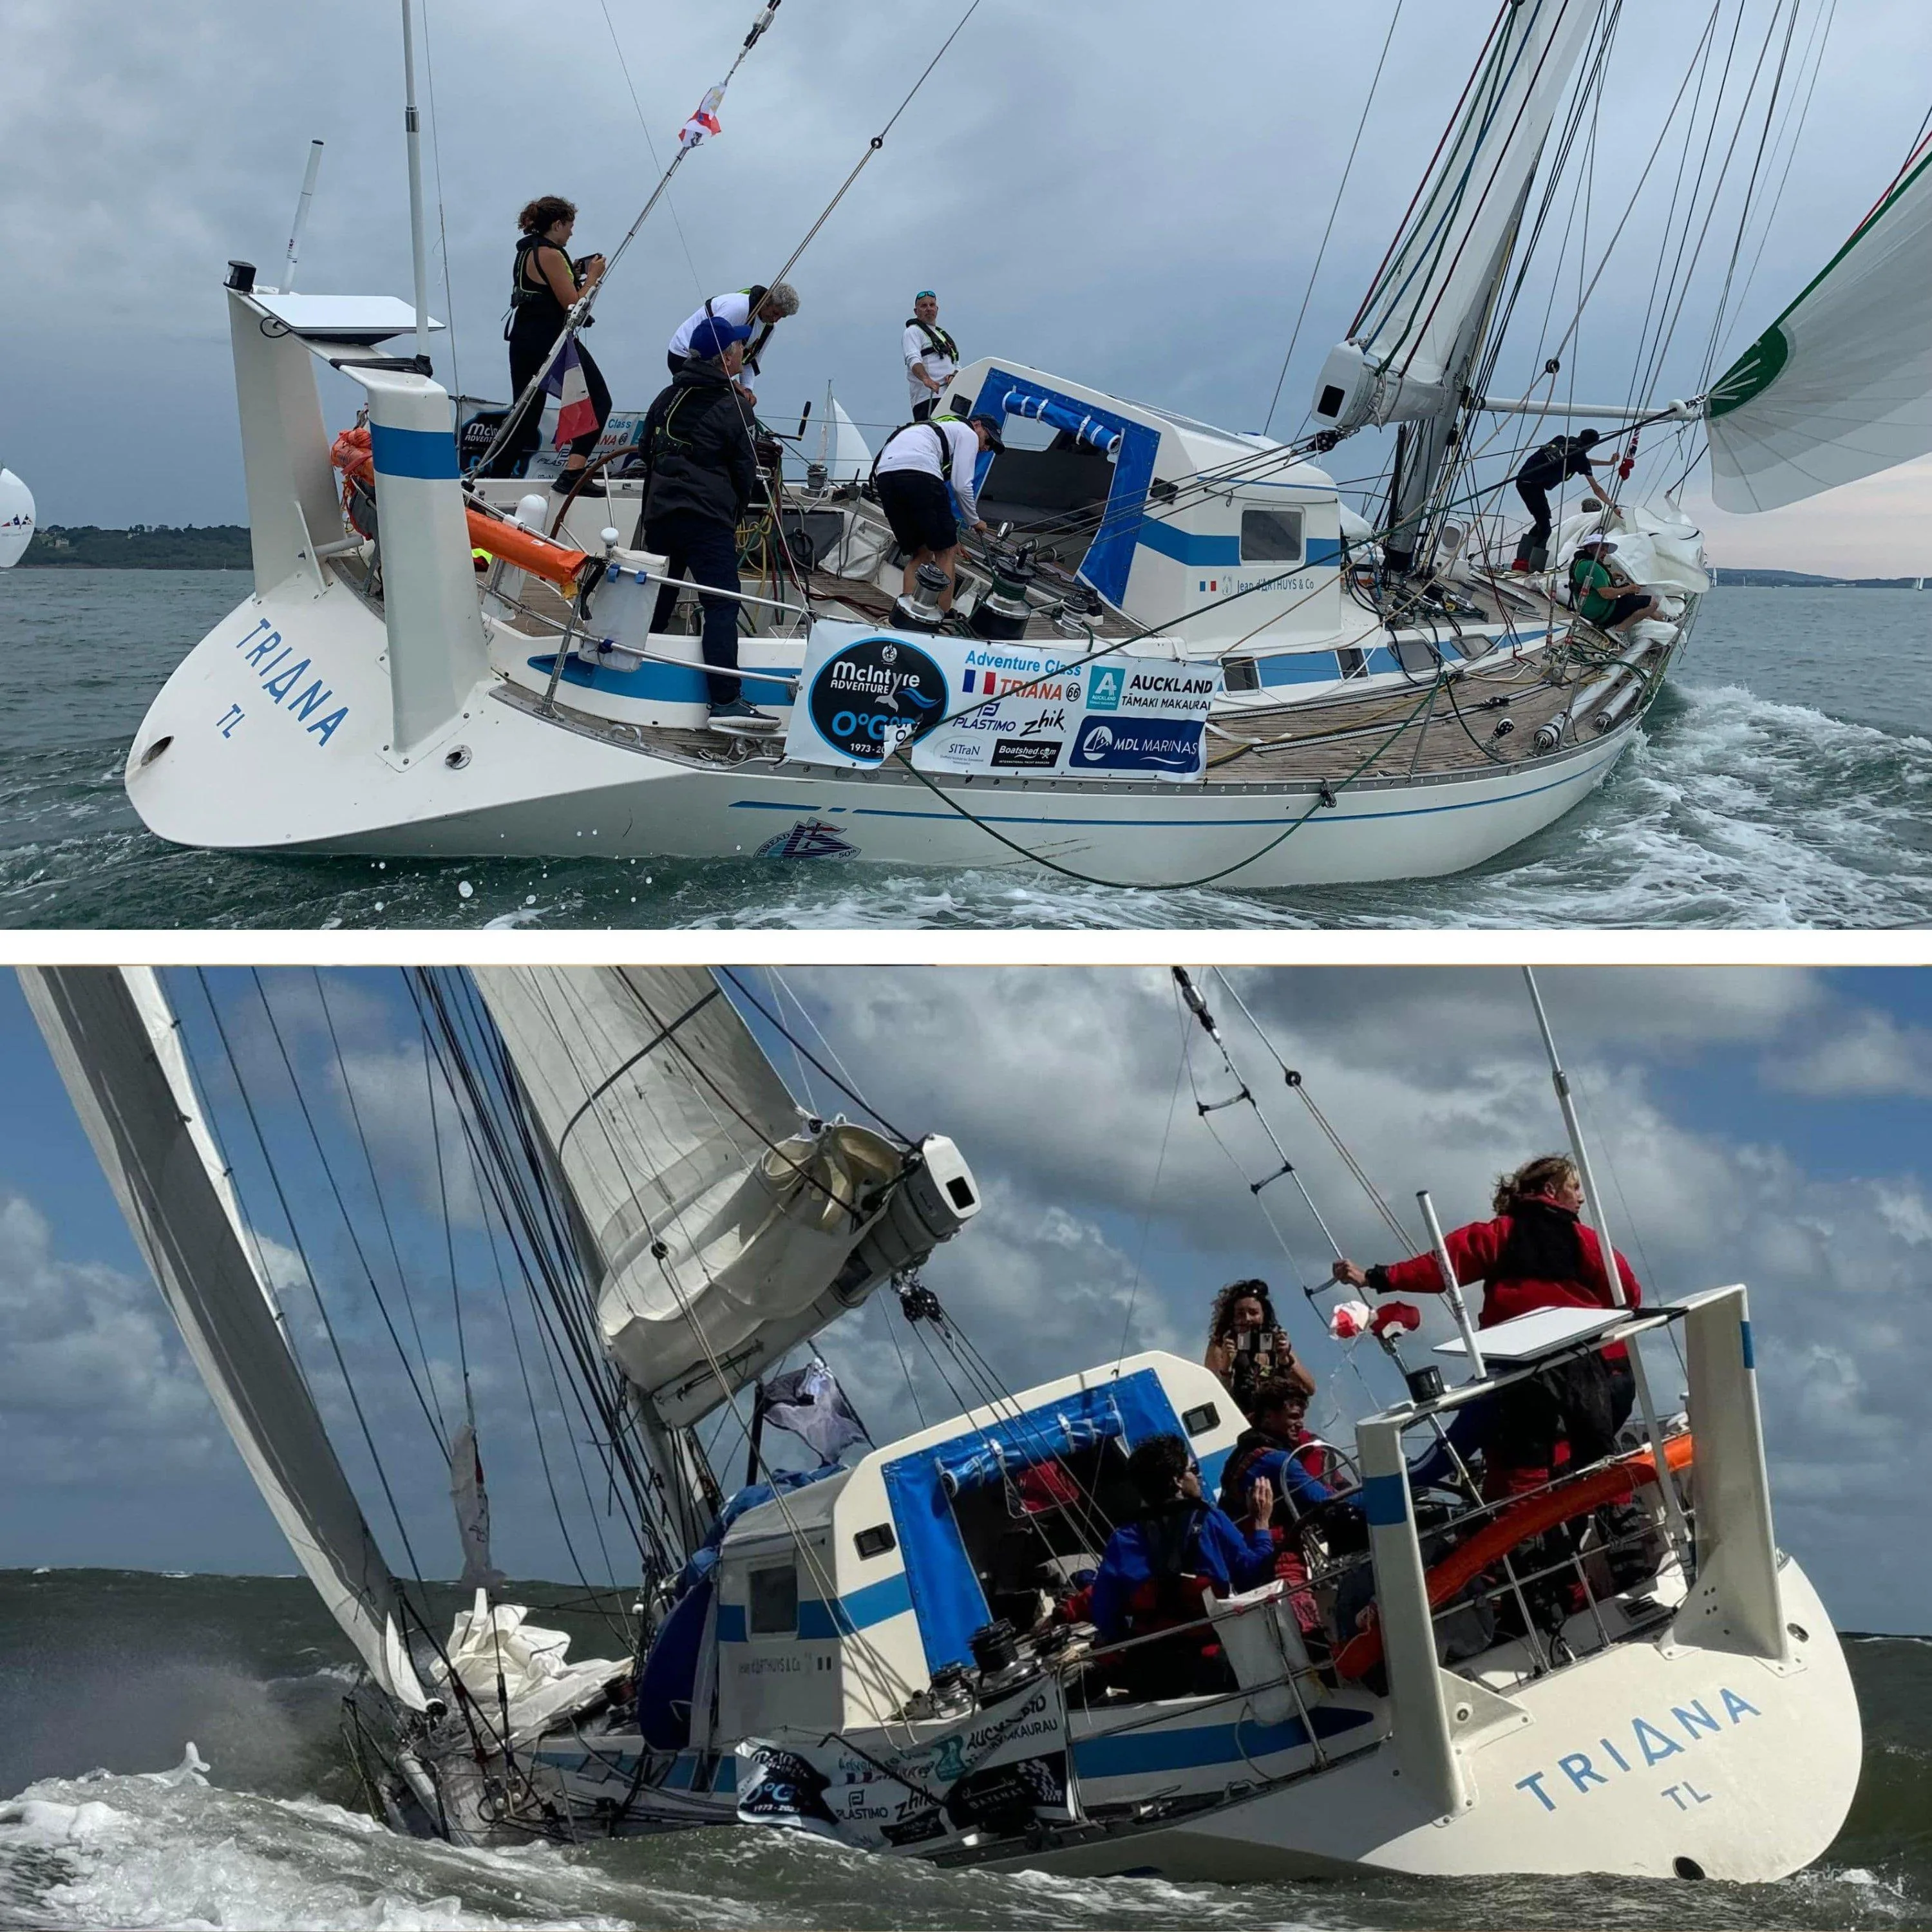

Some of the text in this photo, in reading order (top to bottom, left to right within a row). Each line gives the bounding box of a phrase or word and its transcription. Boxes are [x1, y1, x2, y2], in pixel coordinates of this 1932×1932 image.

[608, 419, 632, 429] Class
[464, 435, 493, 443] ADVENT
[537, 458, 569, 467] PLAST
[1298, 580, 1304, 589] &
[1305, 579, 1314, 589] Co
[965, 650, 1082, 677] Adventure Class
[236, 618, 348, 747] TRIANA
[830, 679, 889, 695] ADVENTURE
[832, 661, 920, 694] McIntyre
[1130, 674, 1213, 694] AUCKLAND
[999, 677, 1080, 701] TRIANA 66
[216, 704, 245, 739] TL
[952, 716, 1016, 732] PLASTIMO
[949, 743, 980, 755] SITraN
[1113, 740, 1198, 755] MDL MARINAS
[1007, 1718, 1057, 1741] AKAURAU
[1515, 1688, 1761, 1812] TRIANA
[1660, 1781, 1712, 1811] TL
